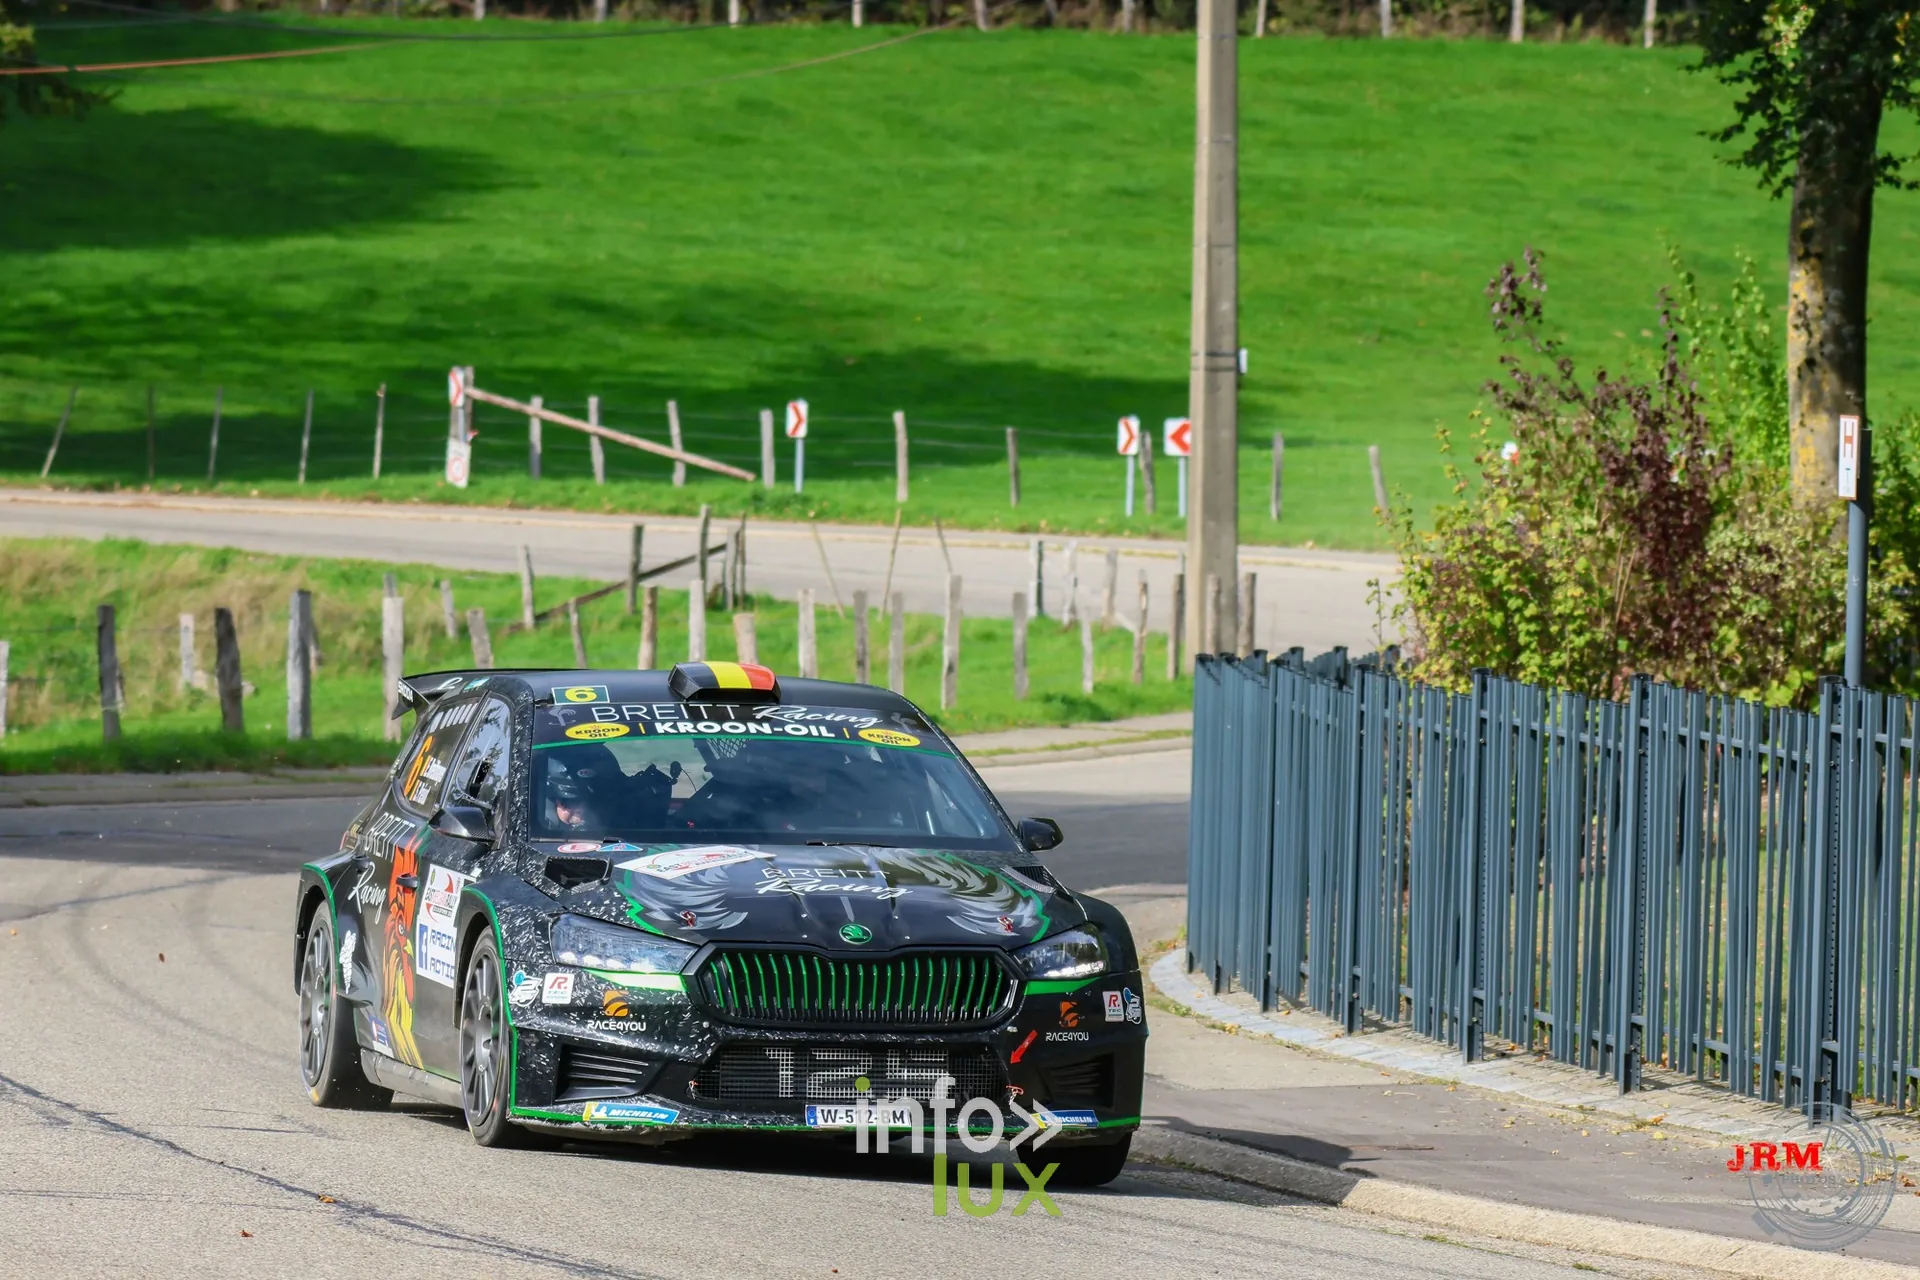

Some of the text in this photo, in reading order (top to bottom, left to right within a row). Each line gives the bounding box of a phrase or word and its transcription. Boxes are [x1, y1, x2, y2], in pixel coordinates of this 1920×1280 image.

[565, 687, 597, 702] 6
[591, 703, 883, 728] BREITT Racing
[575, 727, 621, 735] KROON
[655, 721, 836, 738] KROON-OIL
[867, 732, 911, 742] KROON
[404, 735, 433, 797] 6
[364, 812, 416, 863] BREITT
[761, 868, 890, 879] BREITT
[348, 861, 386, 925] Racing
[755, 877, 914, 899] Racing
[587, 1020, 647, 1032] RACE4YOU
[1045, 1031, 1089, 1042] RACE4YOU
[608, 1109, 669, 1119] MICHELIN
